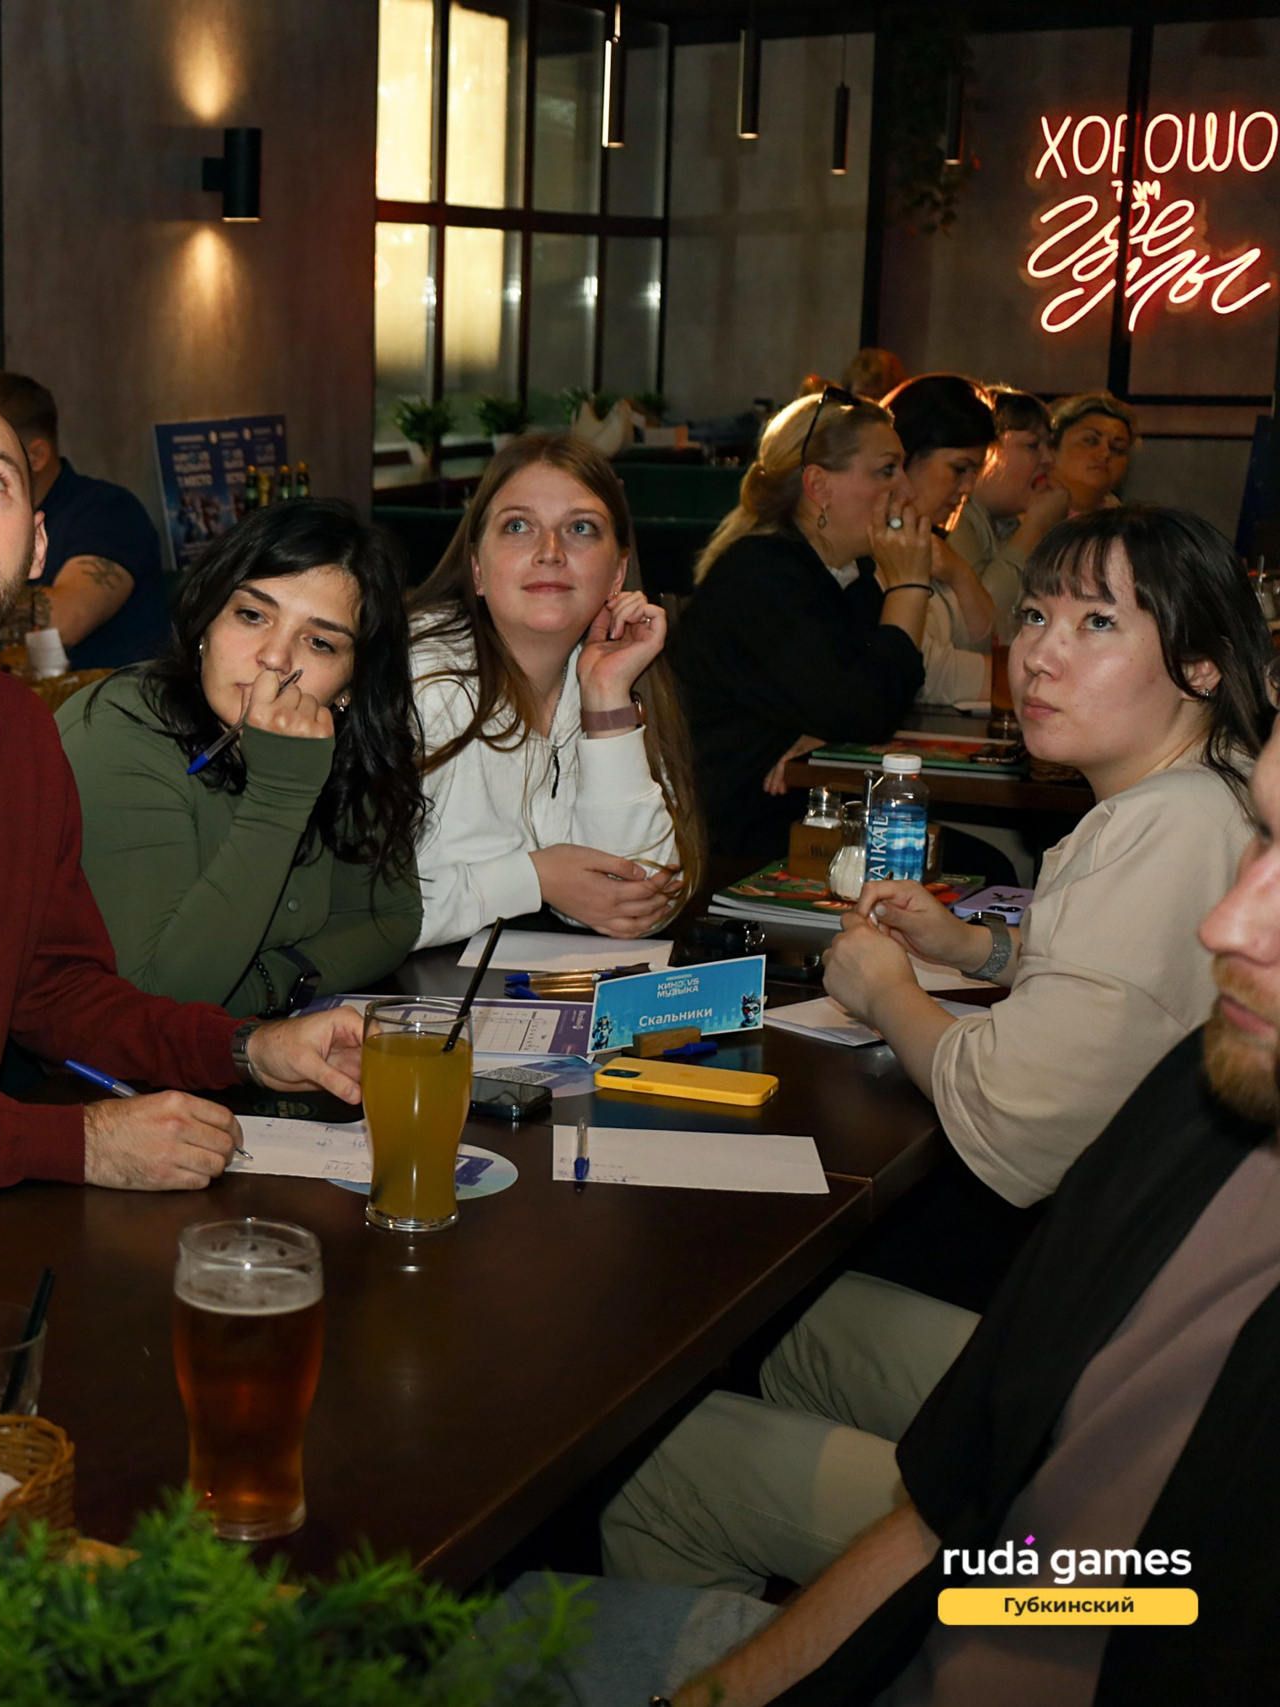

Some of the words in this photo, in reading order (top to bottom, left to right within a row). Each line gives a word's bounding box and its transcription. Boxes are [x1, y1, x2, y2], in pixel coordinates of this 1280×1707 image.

[687, 977, 700, 987] VS
[657, 985, 699, 998] МУЗЫКА
[639, 1007, 713, 1027] Скальники
